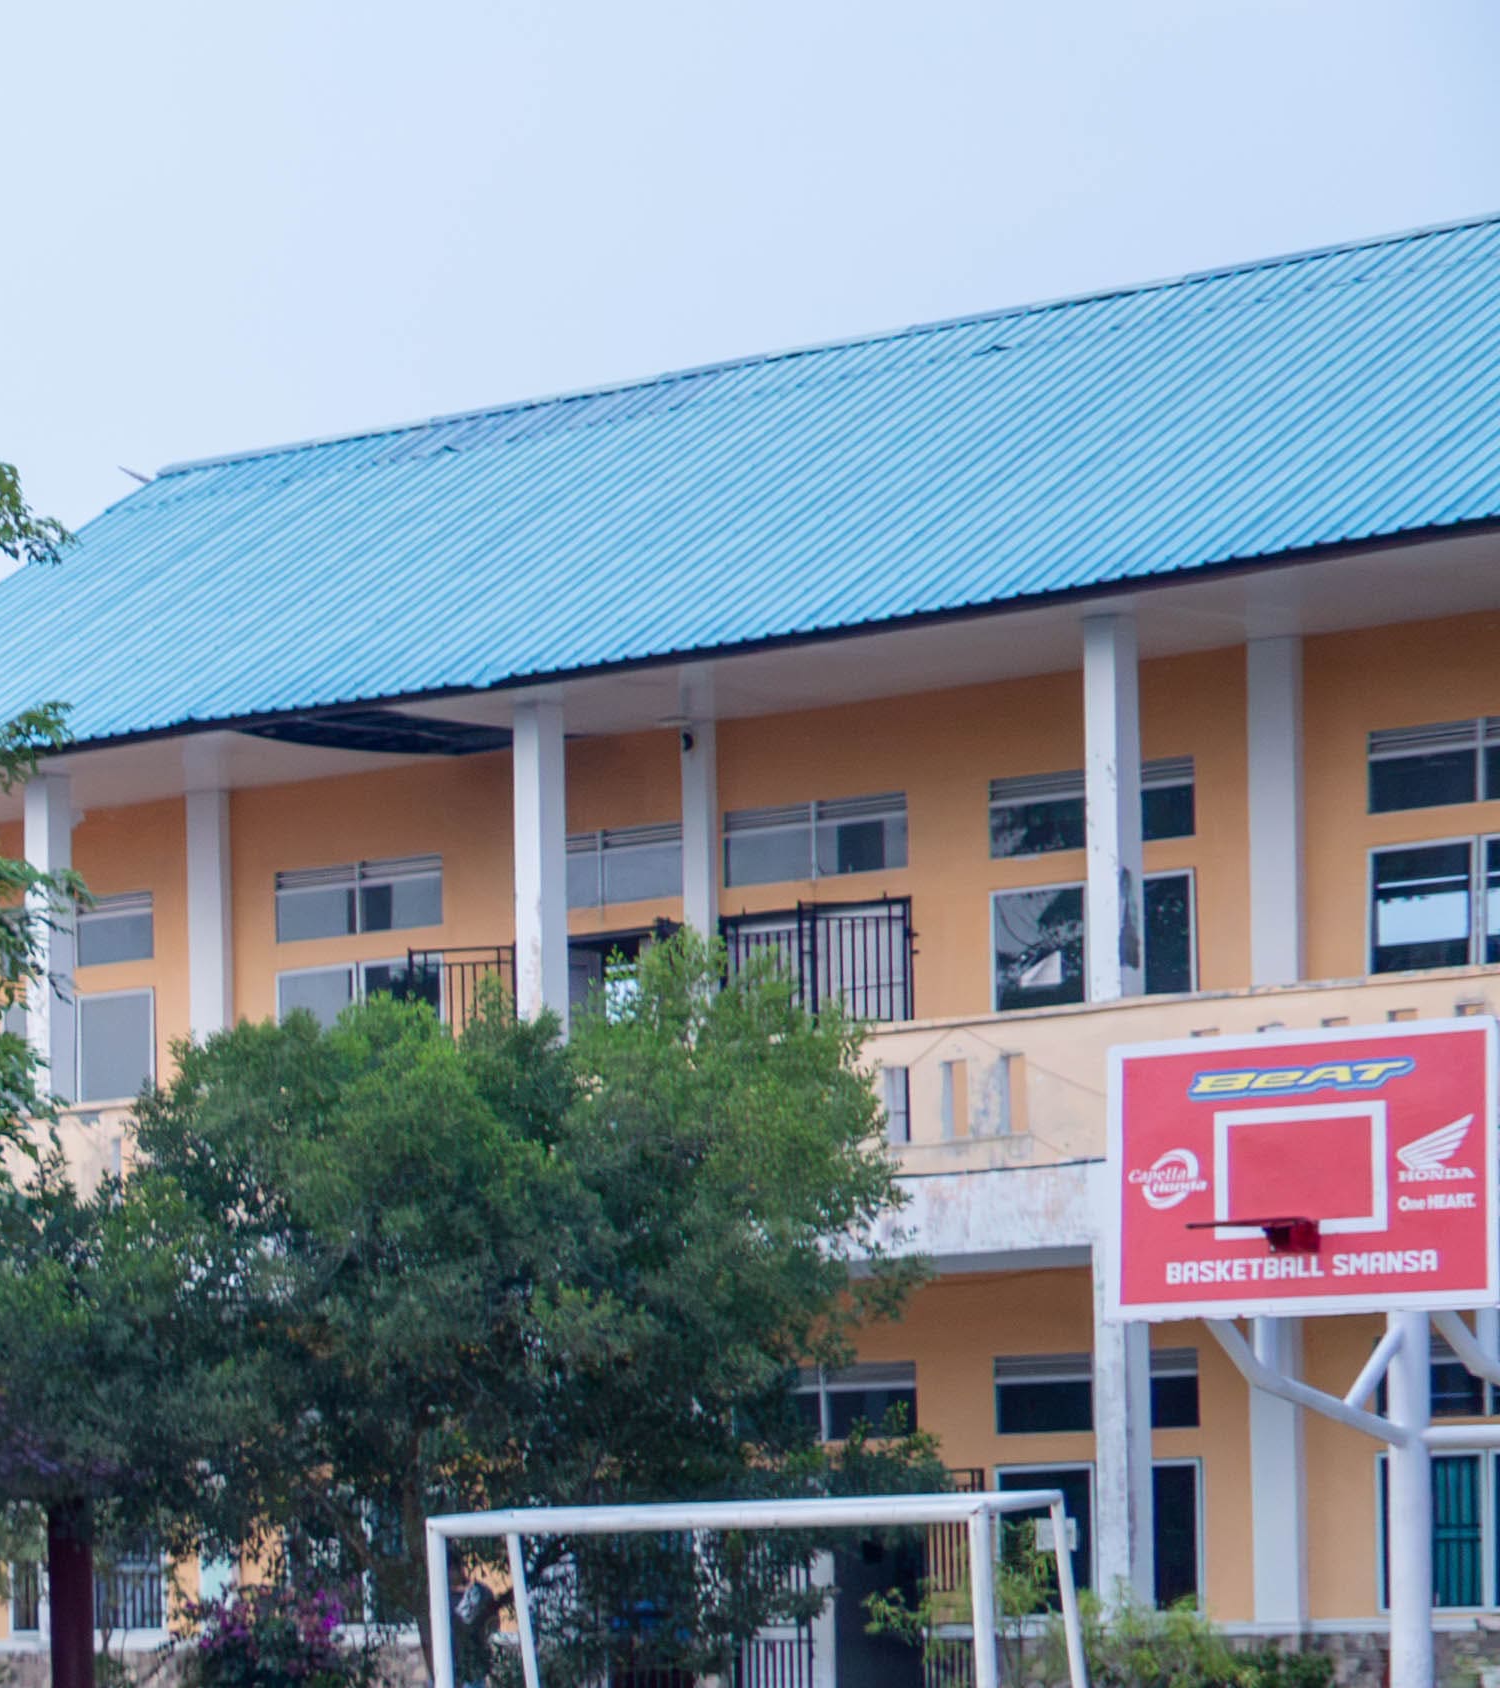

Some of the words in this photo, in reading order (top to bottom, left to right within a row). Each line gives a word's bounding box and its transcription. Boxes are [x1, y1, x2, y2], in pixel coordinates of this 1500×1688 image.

[1128, 1163, 1192, 1186] Capella
[1397, 1166, 1477, 1182] HONDA
[1397, 1195, 1426, 1212] One
[1165, 1252, 1326, 1285] BASKETBALL
[1331, 1248, 1439, 1278] SMANSA
